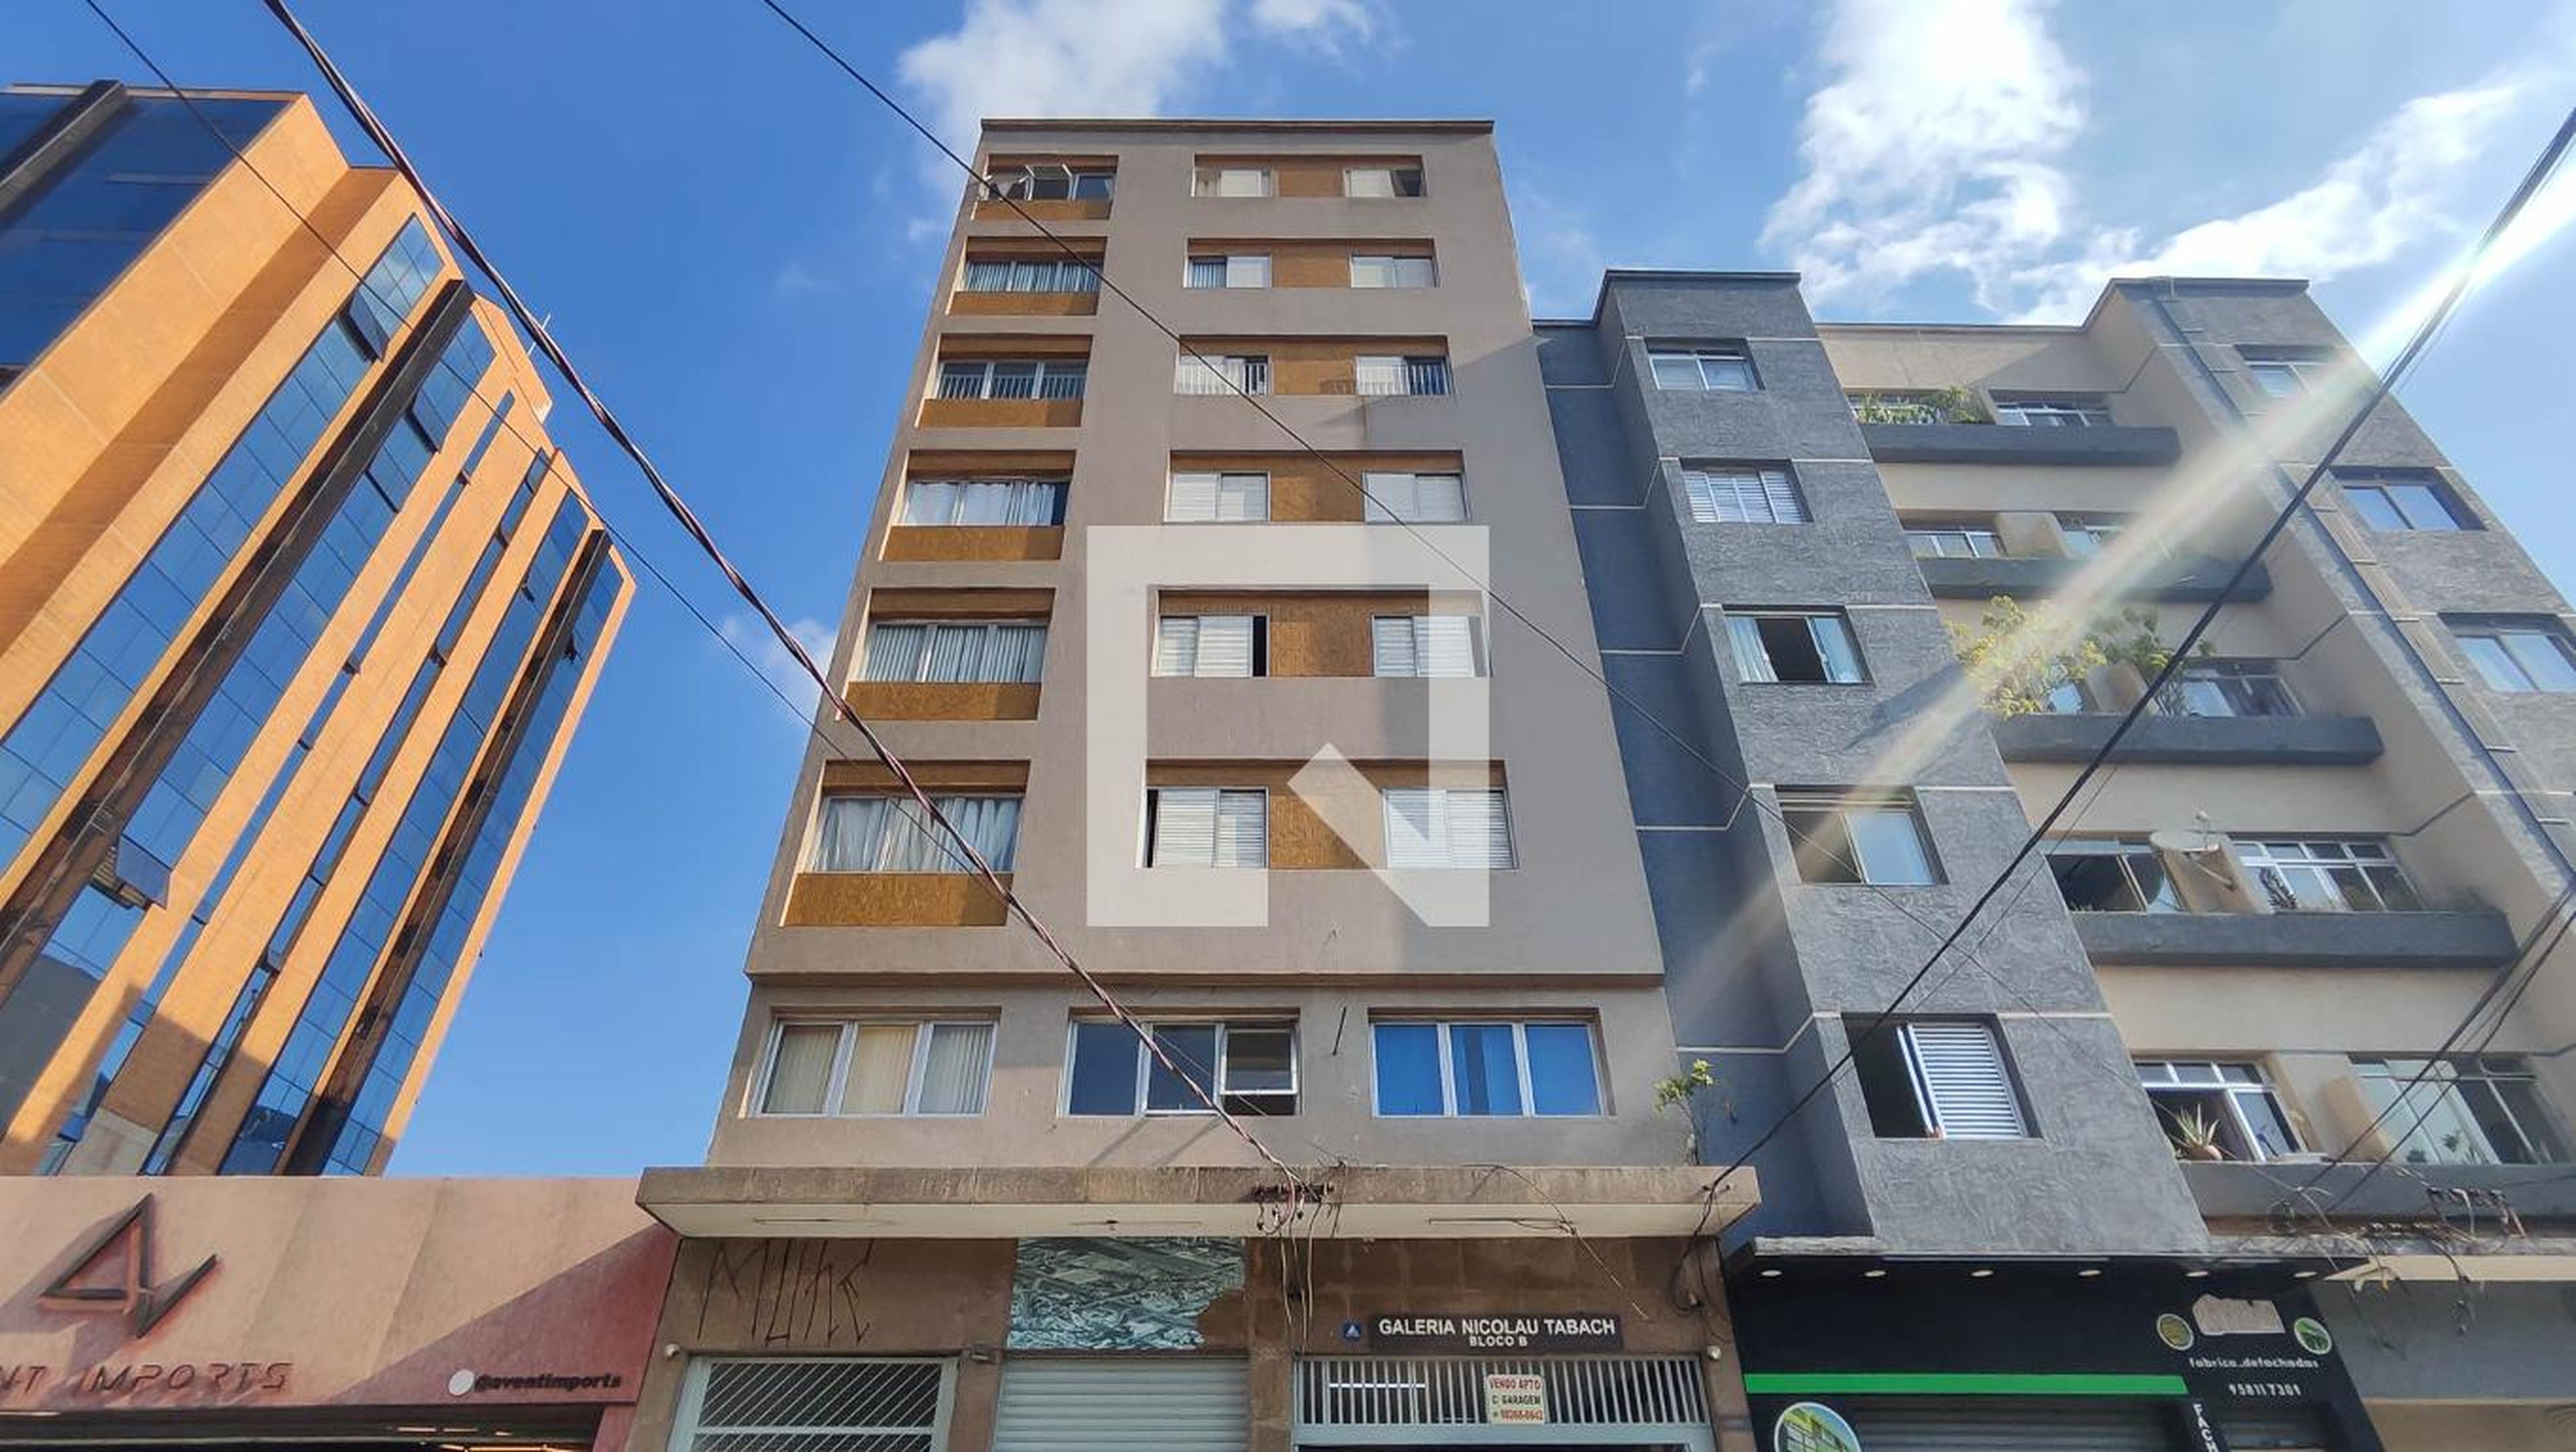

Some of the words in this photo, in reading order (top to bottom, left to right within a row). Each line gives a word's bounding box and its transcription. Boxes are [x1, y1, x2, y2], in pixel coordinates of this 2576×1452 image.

[1379, 1318, 1456, 1335] GALERIA
[1461, 1318, 1538, 1335] NICOLAU
[1544, 1319, 1615, 1335] TABACH
[1469, 1336, 1514, 1347] BLOCO
[1519, 1336, 1527, 1347] B
[75, 1362, 293, 1394] IMPORTS
[1502, 1395, 1541, 1405] GARAGEM
